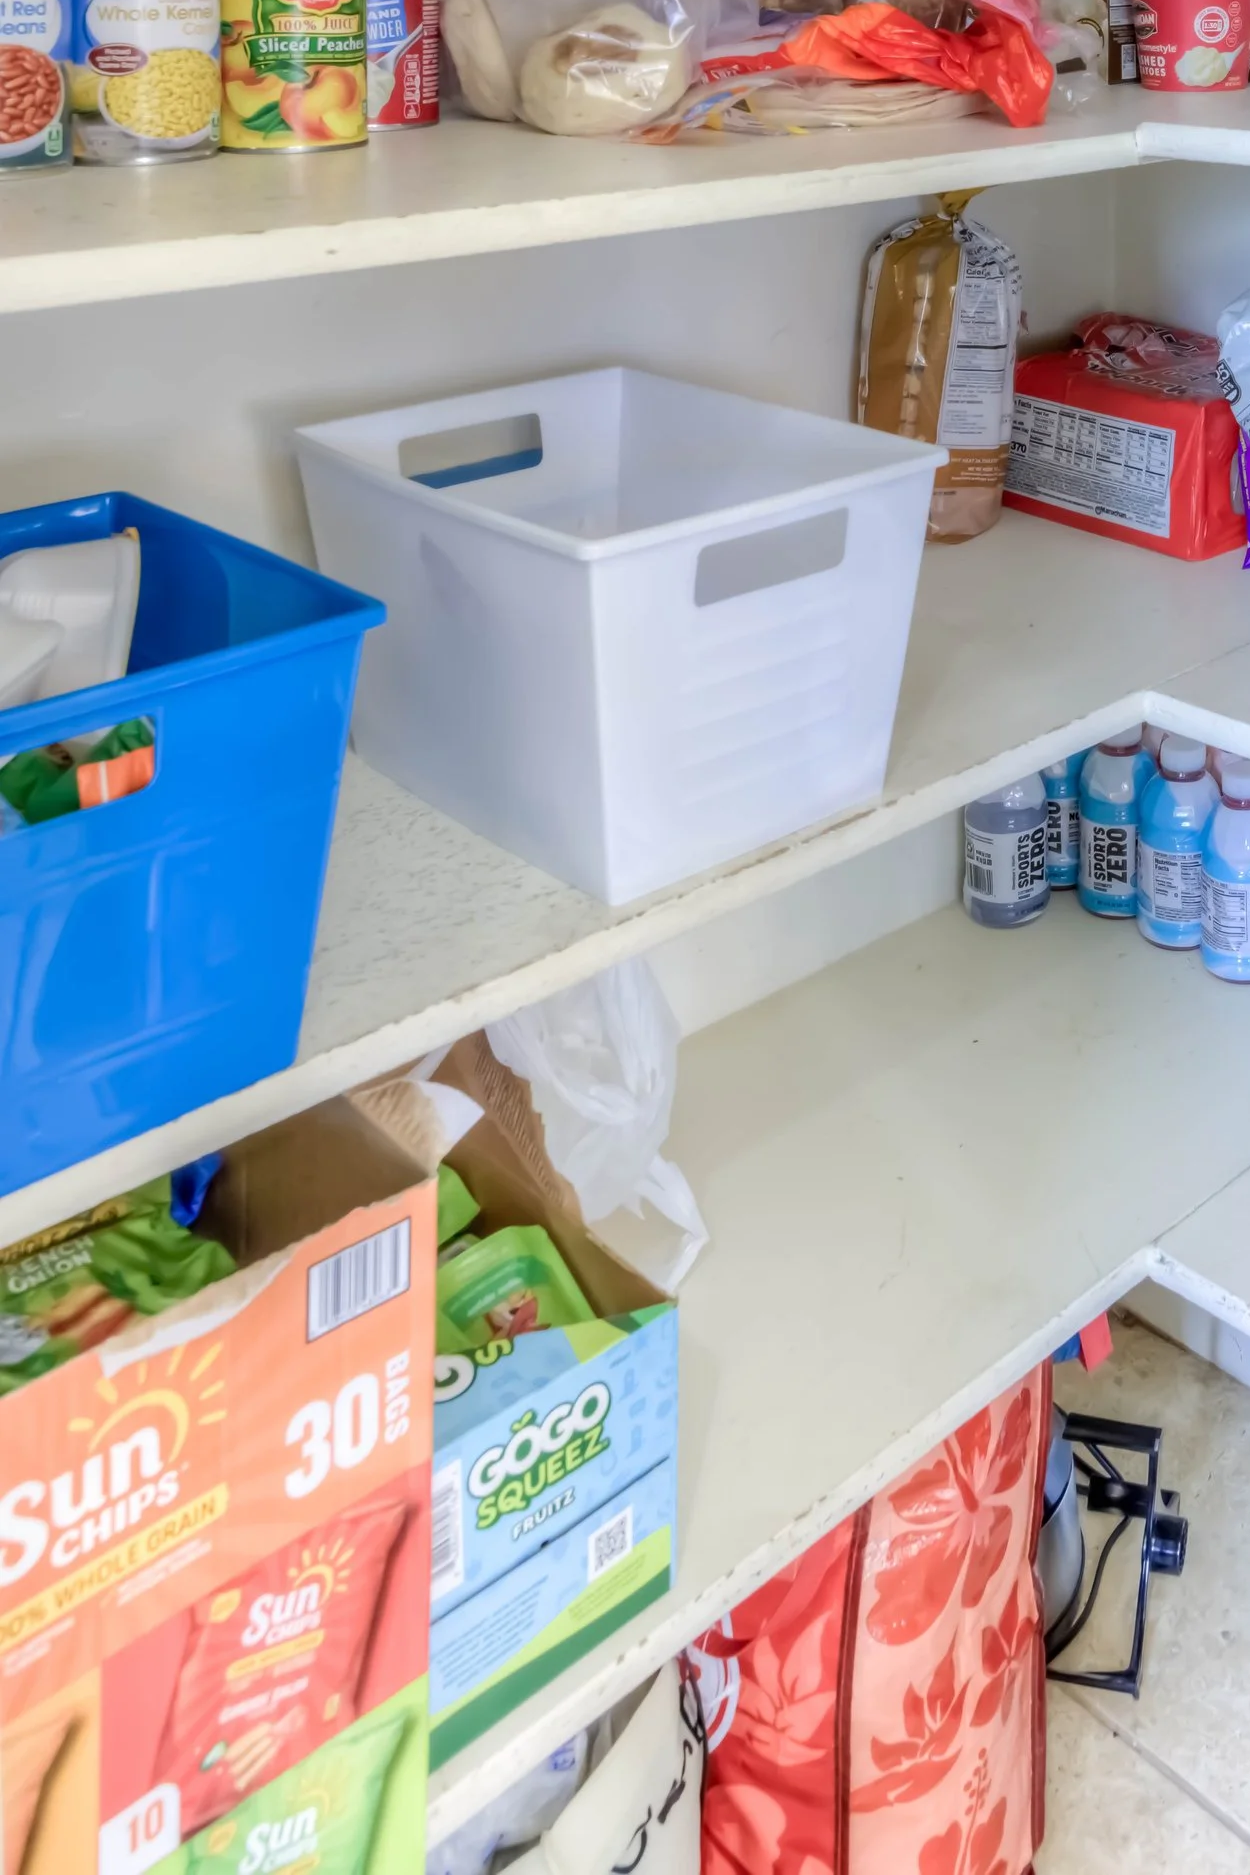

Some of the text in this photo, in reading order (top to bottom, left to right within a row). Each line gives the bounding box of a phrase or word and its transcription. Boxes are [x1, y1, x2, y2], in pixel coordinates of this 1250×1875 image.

[12, 1, 47, 17] Red
[97, 5, 214, 22] Whole Kernel
[277, 19, 317, 32] 100%
[367, 19, 404, 39] WDER
[258, 37, 365, 53] Sliced Peaches
[1138, 55, 1166, 67] SHED
[1010, 441, 1027, 453] 370
[1030, 826, 1046, 886] ZERO
[1048, 801, 1062, 855] ZERO
[1093, 826, 1106, 882] SPORTS
[1106, 827, 1128, 884] ZERO
[1018, 833, 1031, 889] SPORTS
[1154, 858, 1178, 867] Nutrition
[1154, 864, 1170, 872] Facts
[8, 1251, 93, 1294] ONION
[383, 1349, 411, 1445] BAGS
[284, 1372, 380, 1499] 30
[467, 1381, 611, 1499] GOGO
[475, 1425, 610, 1530] SQUEEZ
[0, 1425, 164, 1588] Sun
[49, 1469, 181, 1569] CHIPS
[510, 1486, 576, 1542] FRUITZ
[53, 1496, 218, 1613] WHOLE GRAIN
[242, 1582, 320, 1648] Sun
[128, 1799, 164, 1855] 10
[238, 1806, 318, 1875] Sun
